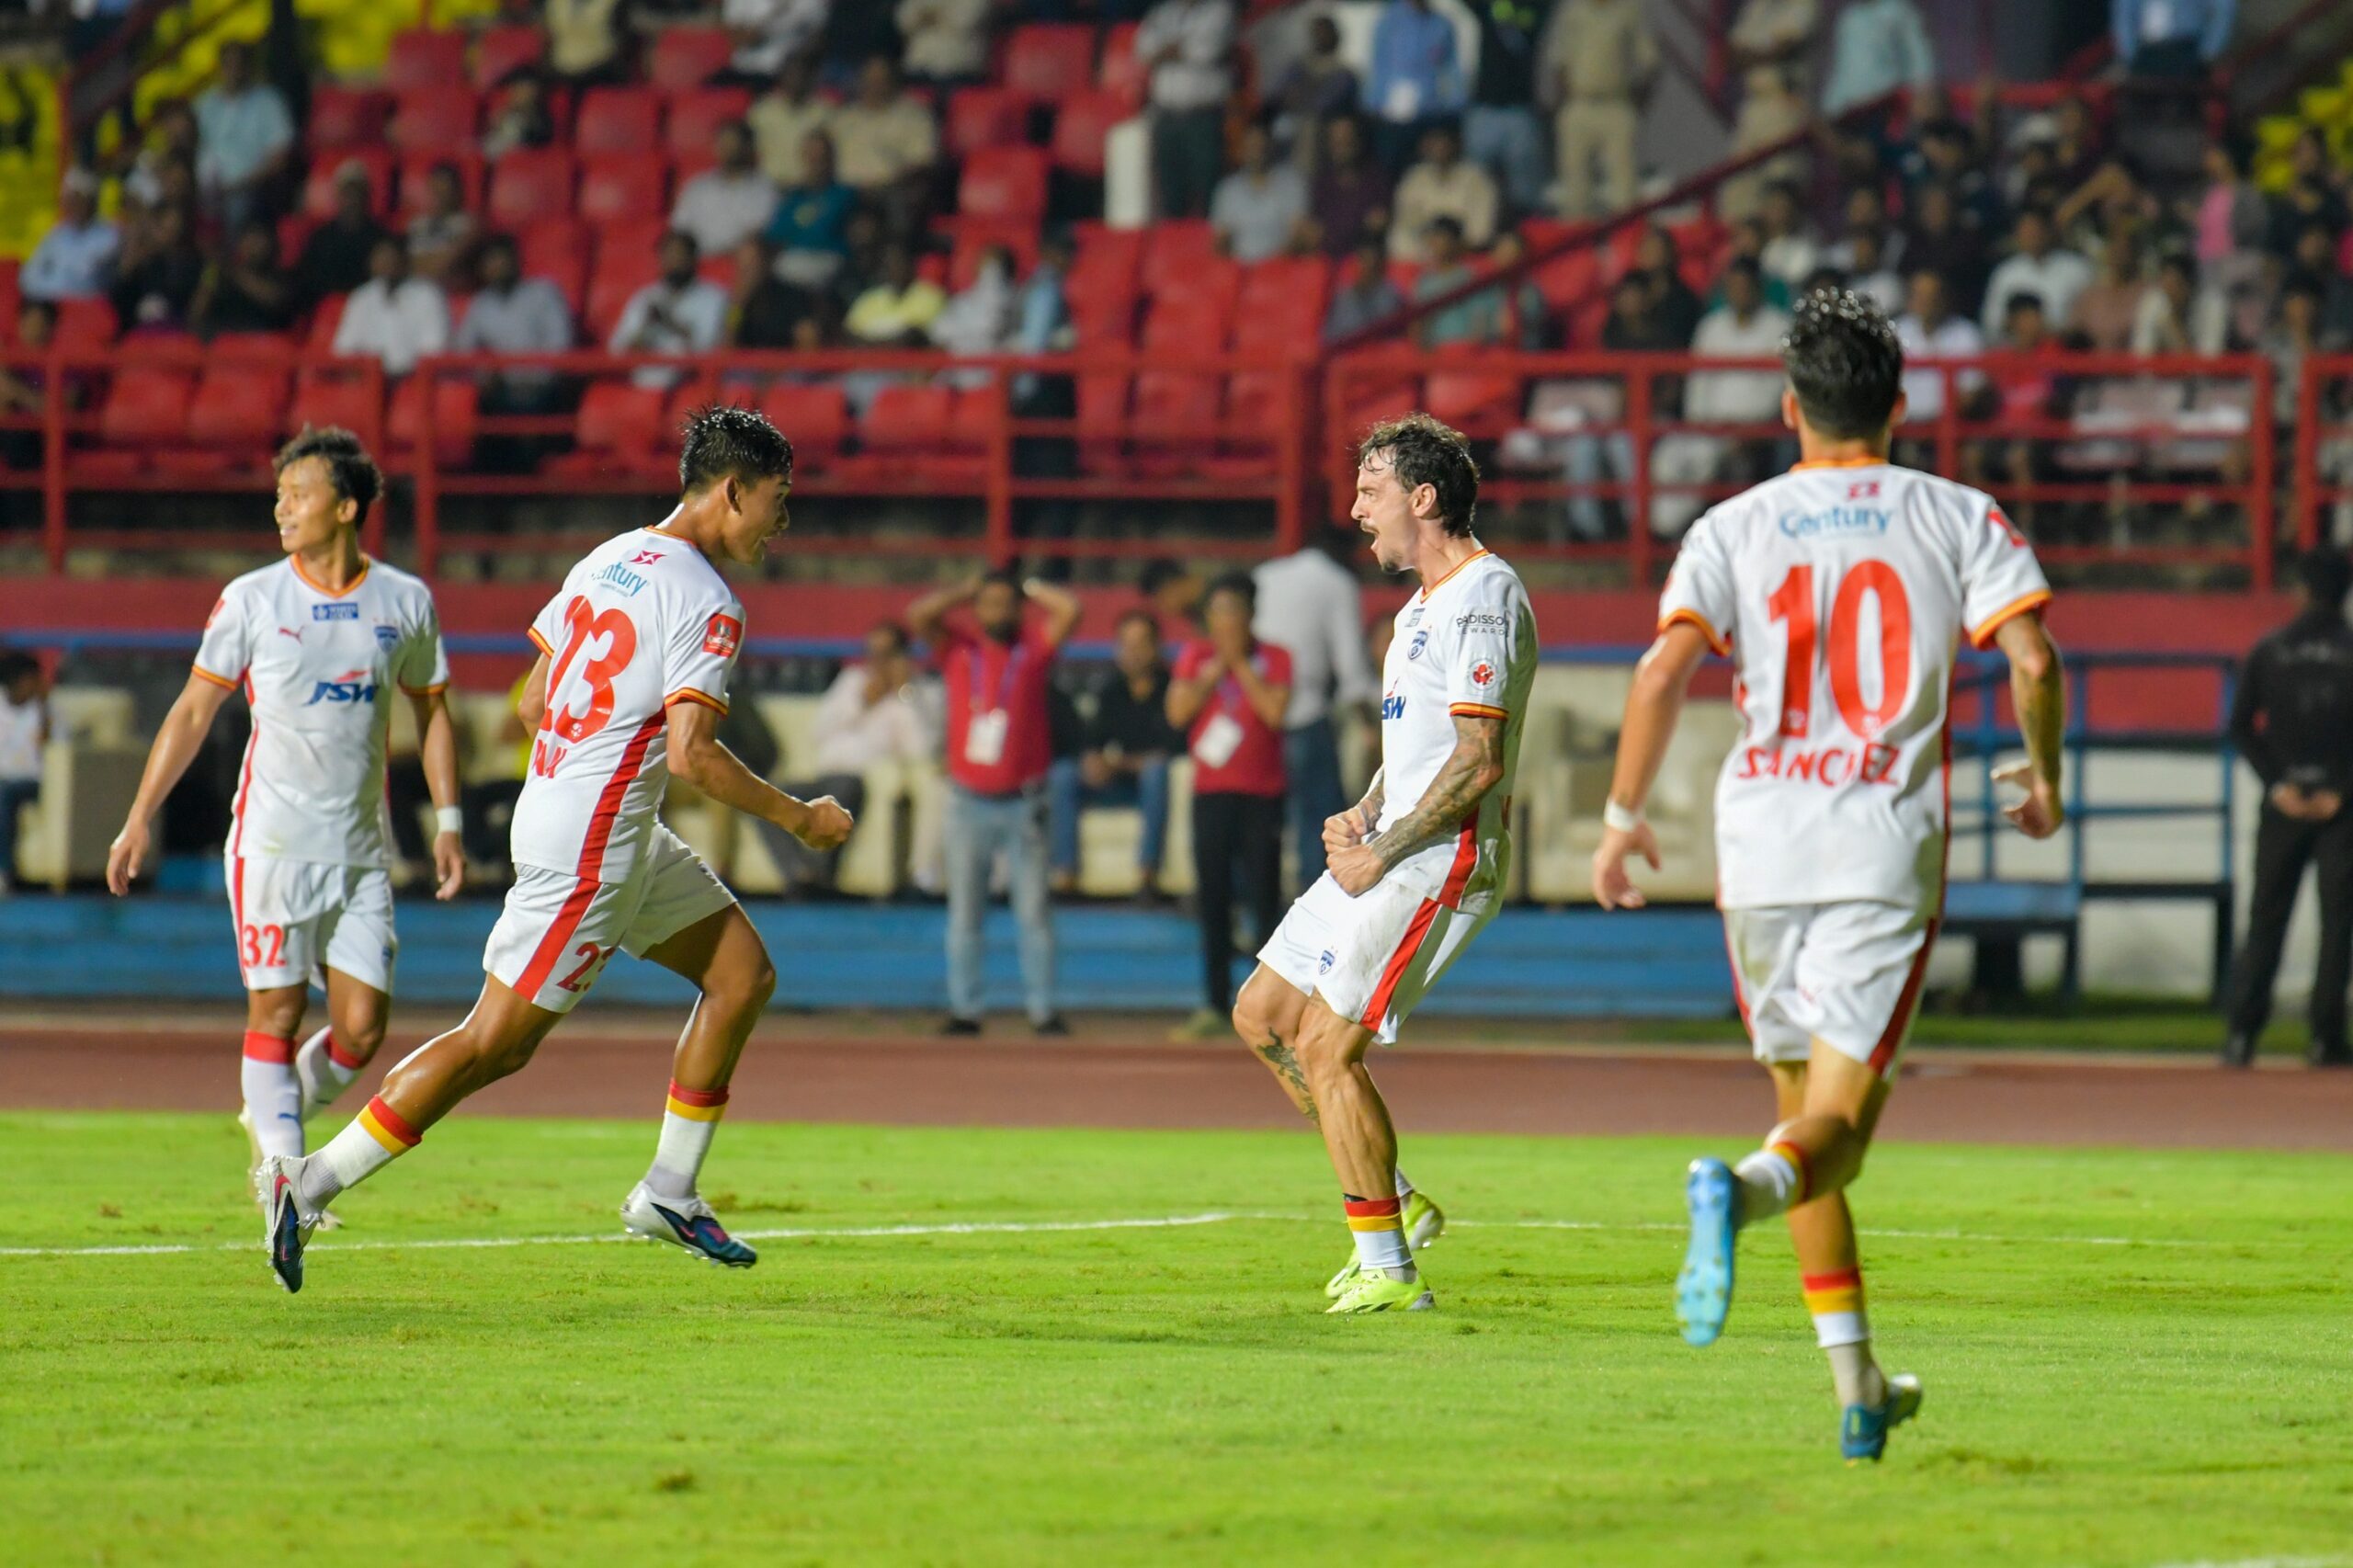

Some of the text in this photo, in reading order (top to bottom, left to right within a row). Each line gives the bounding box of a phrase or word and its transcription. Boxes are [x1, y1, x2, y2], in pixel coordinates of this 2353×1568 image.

[1779, 506, 1893, 539] Century
[591, 562, 648, 597] ntury
[1456, 614, 1509, 628] RADISSO
[1458, 627, 1508, 638] EWARD
[1767, 558, 1911, 740] 10
[540, 595, 637, 744] 23
[303, 682, 380, 706] JSW
[1381, 696, 1406, 720] SW
[241, 924, 288, 968] 32
